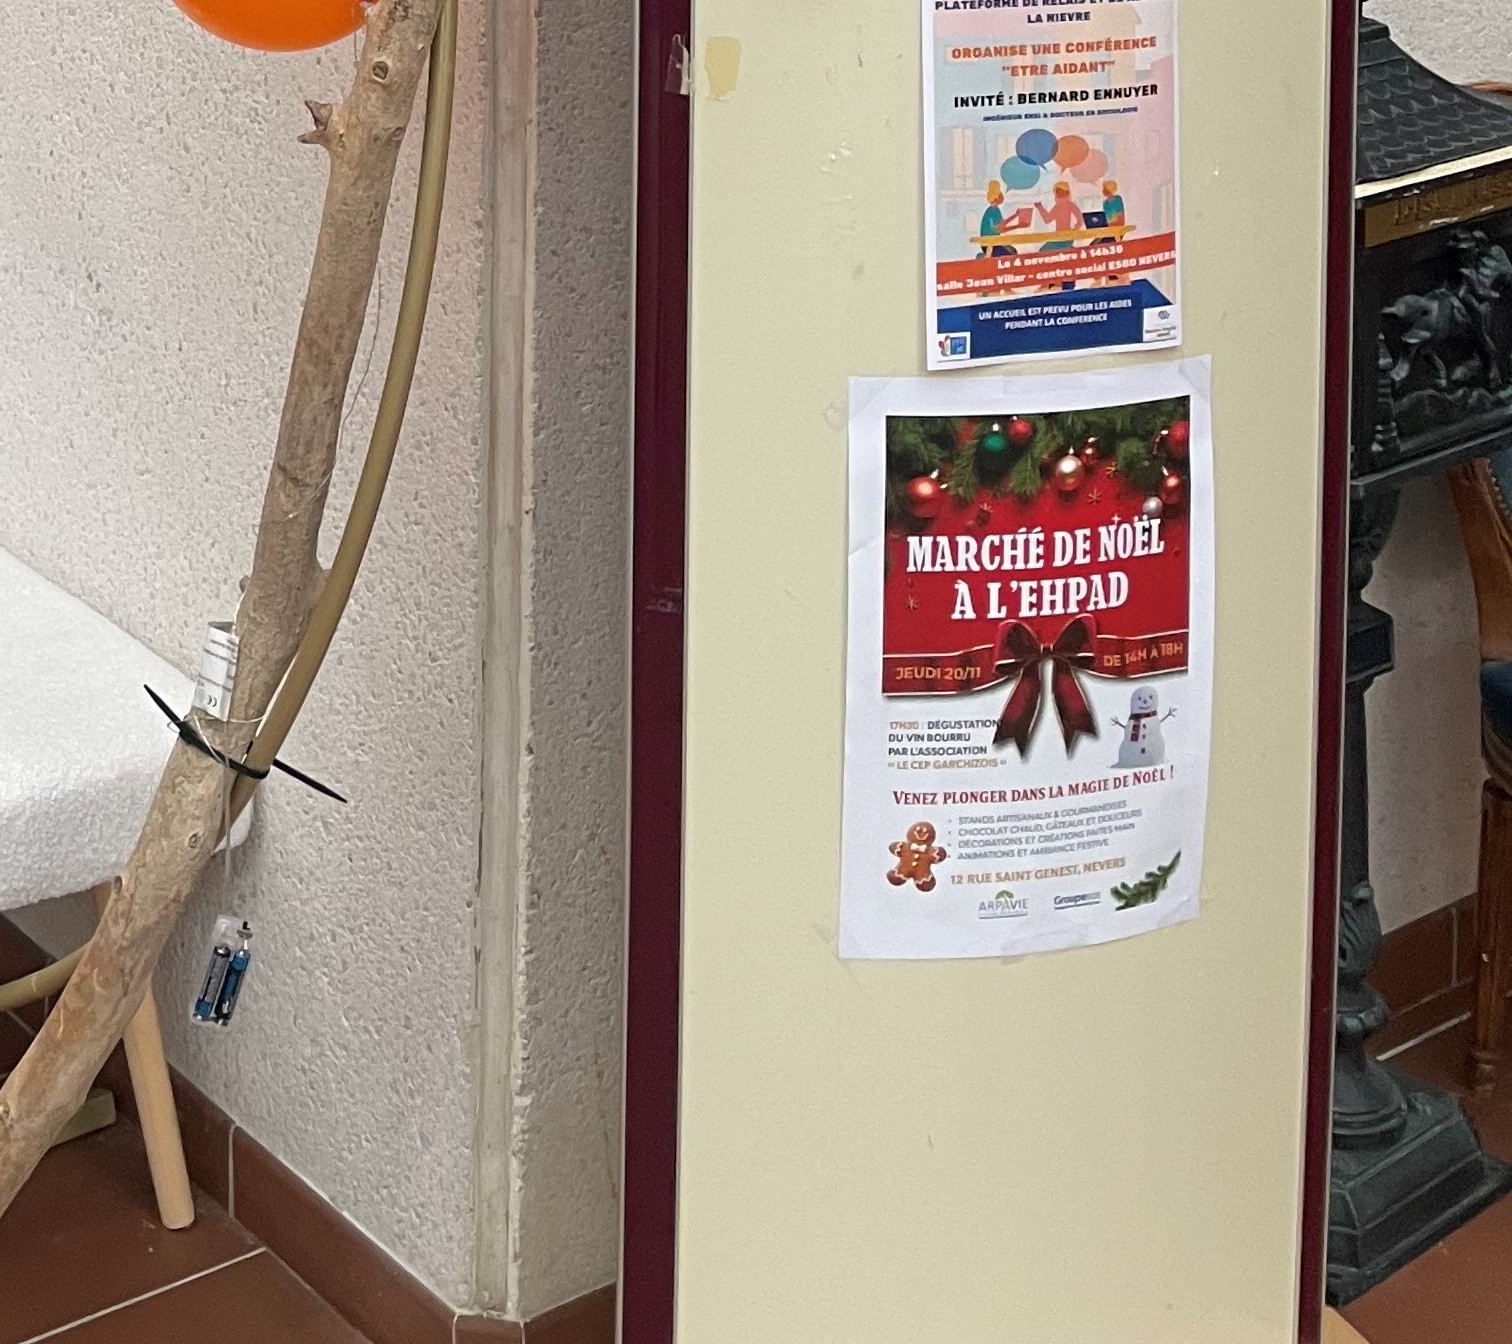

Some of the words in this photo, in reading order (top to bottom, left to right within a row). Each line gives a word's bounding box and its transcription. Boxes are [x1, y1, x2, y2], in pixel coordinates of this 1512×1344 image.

[1026, 13, 1044, 24] LA
[1046, 11, 1091, 23] NIEVRE
[951, 44, 1027, 60] ORGANISE
[1031, 42, 1061, 55] UNE
[1065, 35, 1157, 54] CONFÉRENCE
[1002, 63, 1048, 77] "ETRE
[1053, 60, 1116, 75] AIDANT"
[954, 91, 1005, 108] INVITÉ
[1017, 90, 1089, 105] BERNARD
[1093, 84, 1159, 100] ENNUYER
[998, 259, 1011, 269] Le
[1013, 258, 1022, 267] 4
[1024, 252, 1078, 266] novembre
[1080, 249, 1087, 260] à
[966, 278, 995, 289] Jean
[997, 274, 1026, 285] Villar
[1036, 269, 1073, 280] centre
[1075, 262, 1106, 275] social
[978, 310, 992, 321] UN
[993, 308, 1027, 320] ACCUEIL
[1028, 306, 1042, 317] EST
[1070, 303, 1094, 314] POUR
[1094, 300, 1108, 311] LES
[1005, 318, 1044, 330] PENDANT
[1044, 316, 1055, 327] LA
[1057, 313, 1108, 326] CONFERENCE
[906, 527, 1045, 573] MARCHÉ
[1052, 528, 1092, 568] DE
[1098, 514, 1165, 563] NOËL
[951, 579, 977, 620] À
[987, 571, 1130, 620] L'EHPAD
[1103, 654, 1121, 667] DE
[1124, 648, 1148, 665] 14H
[895, 666, 942, 681] JEUDI
[942, 666, 981, 680] 20/11
[927, 718, 1000, 730] DÉGUSTATION
[888, 733, 903, 742] DU
[906, 733, 925, 742] VIN
[926, 733, 971, 742] BOURRU
[888, 747, 908, 756] PAR
[910, 746, 988, 756] L'ASSOCIATION
[896, 760, 909, 770] LE
[910, 760, 931, 769] CEP
[893, 790, 938, 805] VENEZ
[942, 790, 1008, 805] PLONGER
[1011, 787, 1046, 803] DANS
[1048, 785, 1064, 799] LA
[1068, 778, 1110, 796] MAGIE
[1113, 775, 1129, 790] DE
[958, 815, 995, 825] STANDS
[958, 826, 1008, 837] CHOCOLAT
[1085, 816, 1096, 826] ET
[958, 837, 1023, 849] DÉCORATIONS
[1024, 835, 1036, 845] ET
[957, 849, 1015, 860] ANIMATIONS
[1016, 847, 1028, 857] ET
[950, 874, 963, 885] 12
[967, 873, 992, 884] RUE
[995, 870, 1032, 883] SAINT
[1034, 864, 1082, 879] GENEST,
[1083, 856, 1126, 873] NEVERS
[978, 898, 1028, 912] ARPAVIE
